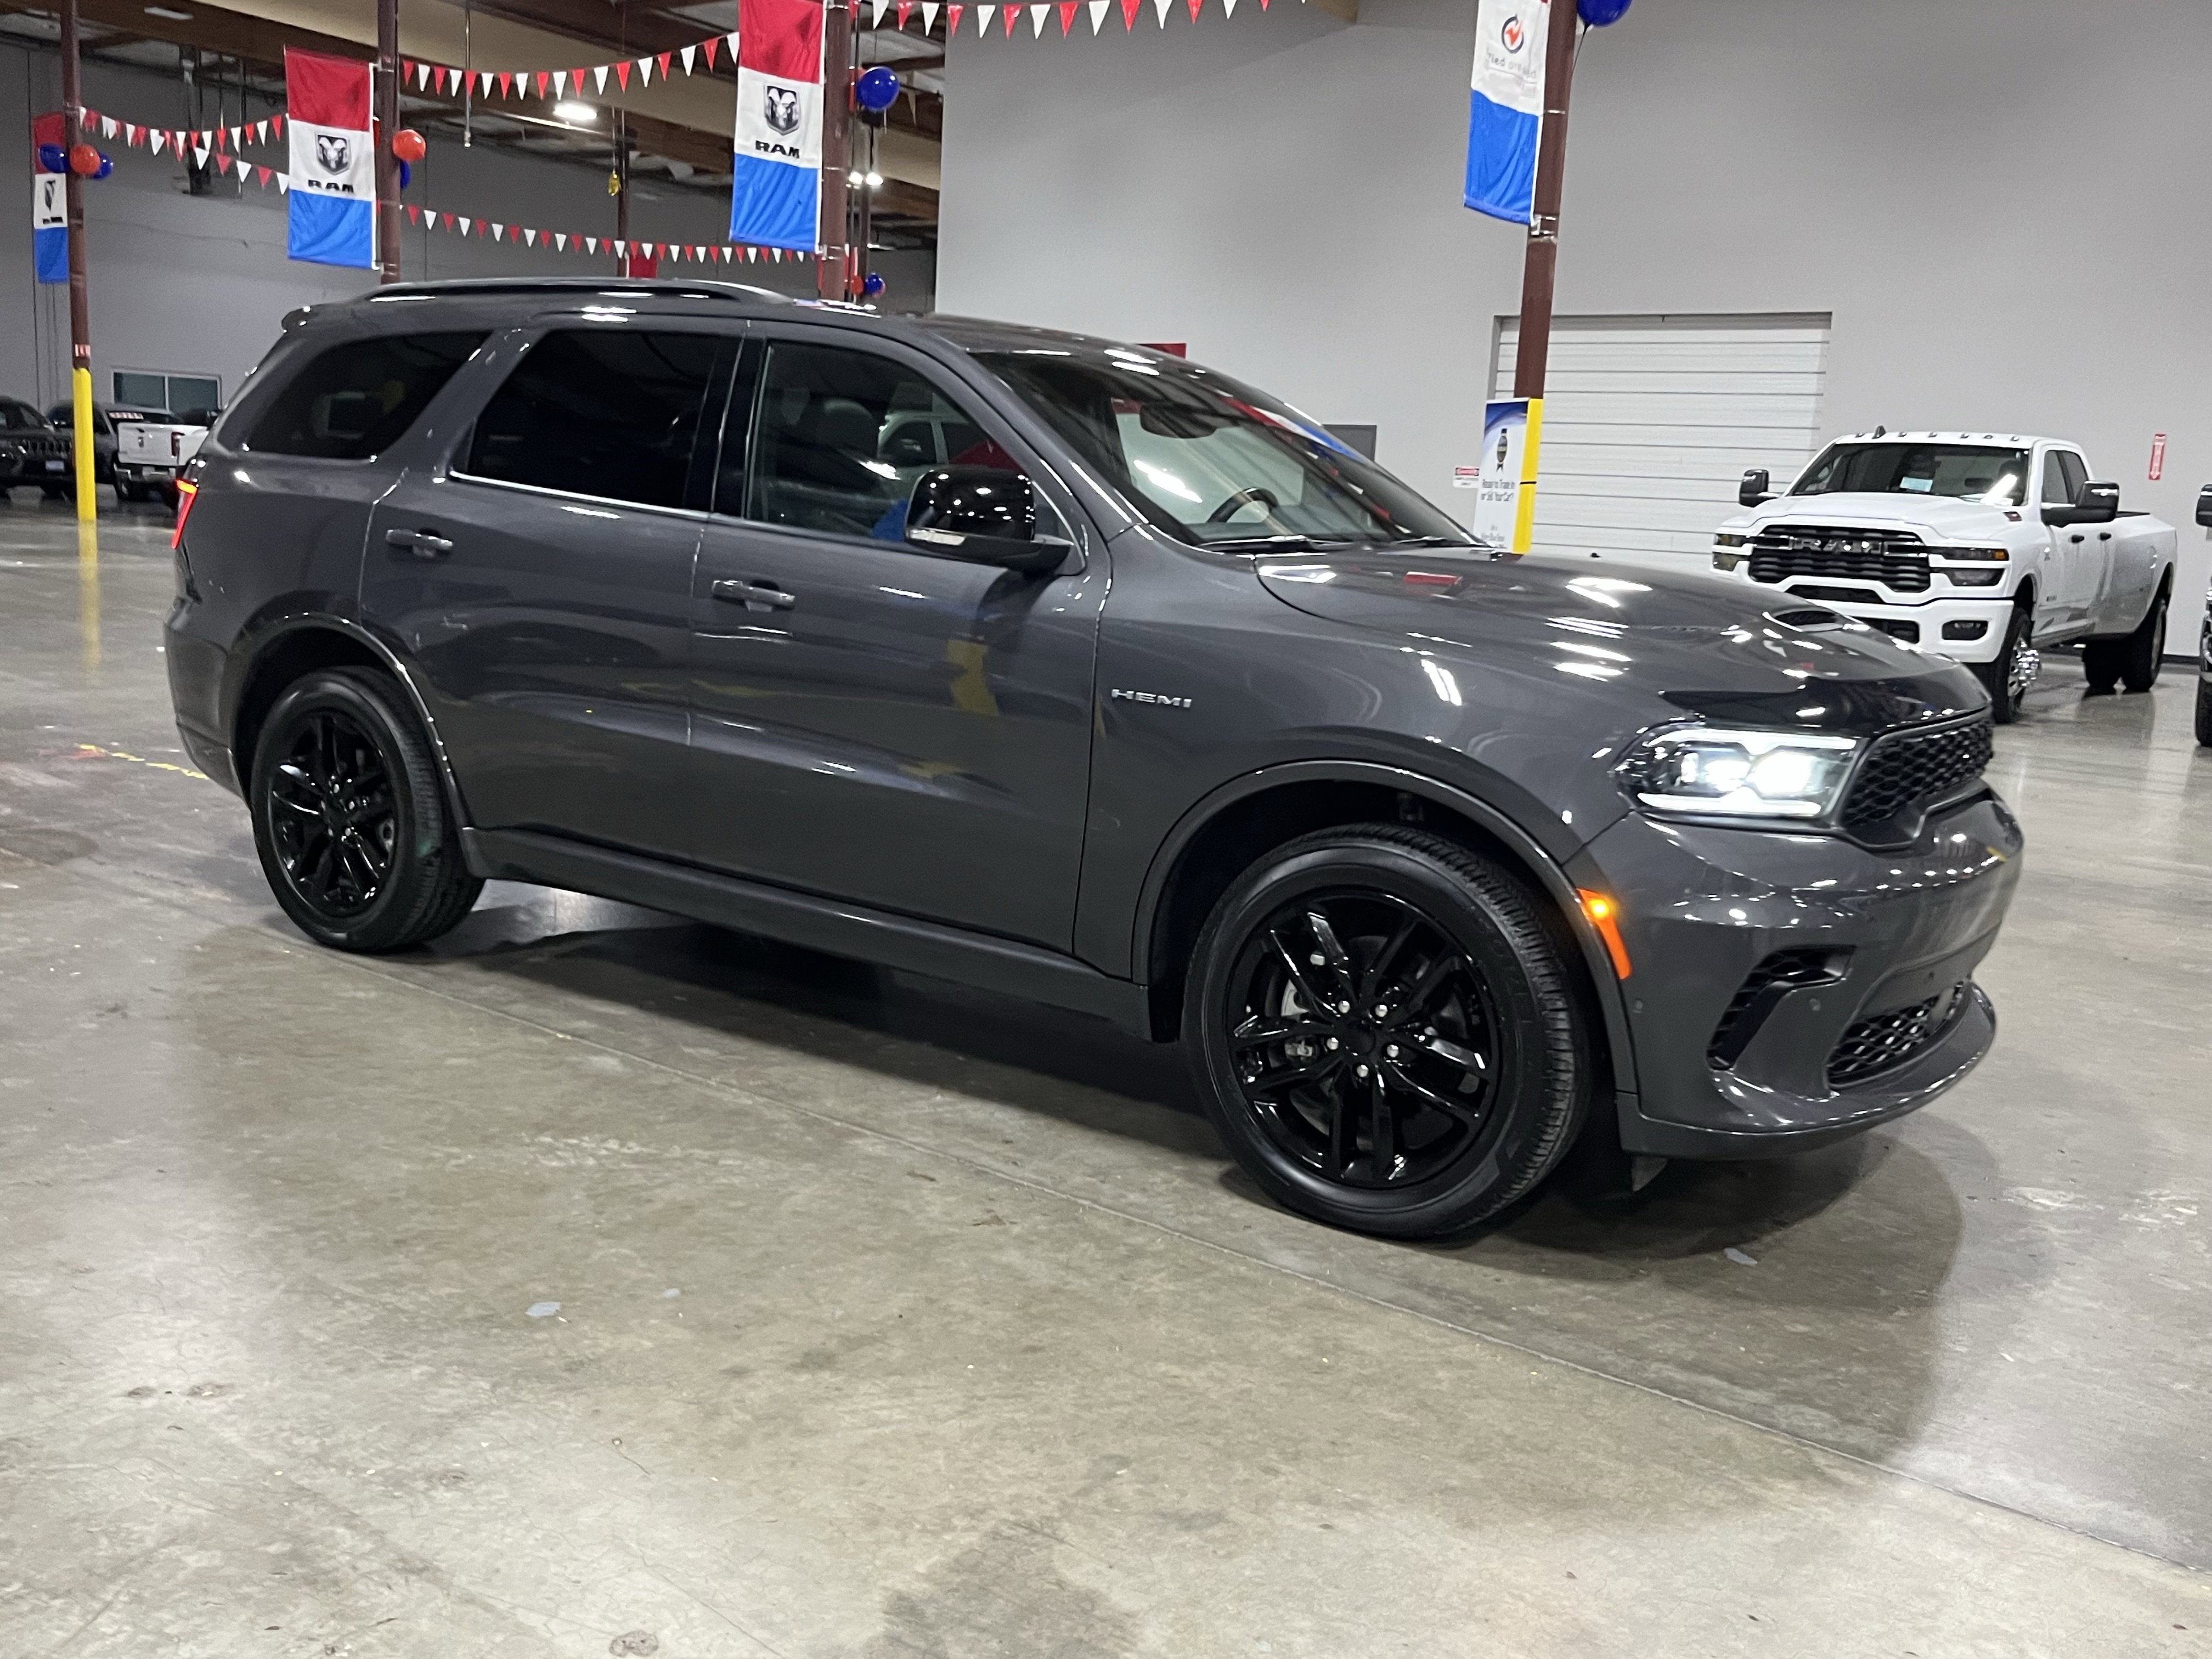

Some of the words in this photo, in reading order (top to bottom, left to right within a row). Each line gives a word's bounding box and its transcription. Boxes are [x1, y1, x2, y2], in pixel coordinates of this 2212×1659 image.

[755, 140, 799, 159] RAM
[308, 179, 354, 193] RAM
[1791, 537, 1882, 554] RAM
[1111, 689, 1192, 708] HEMI
